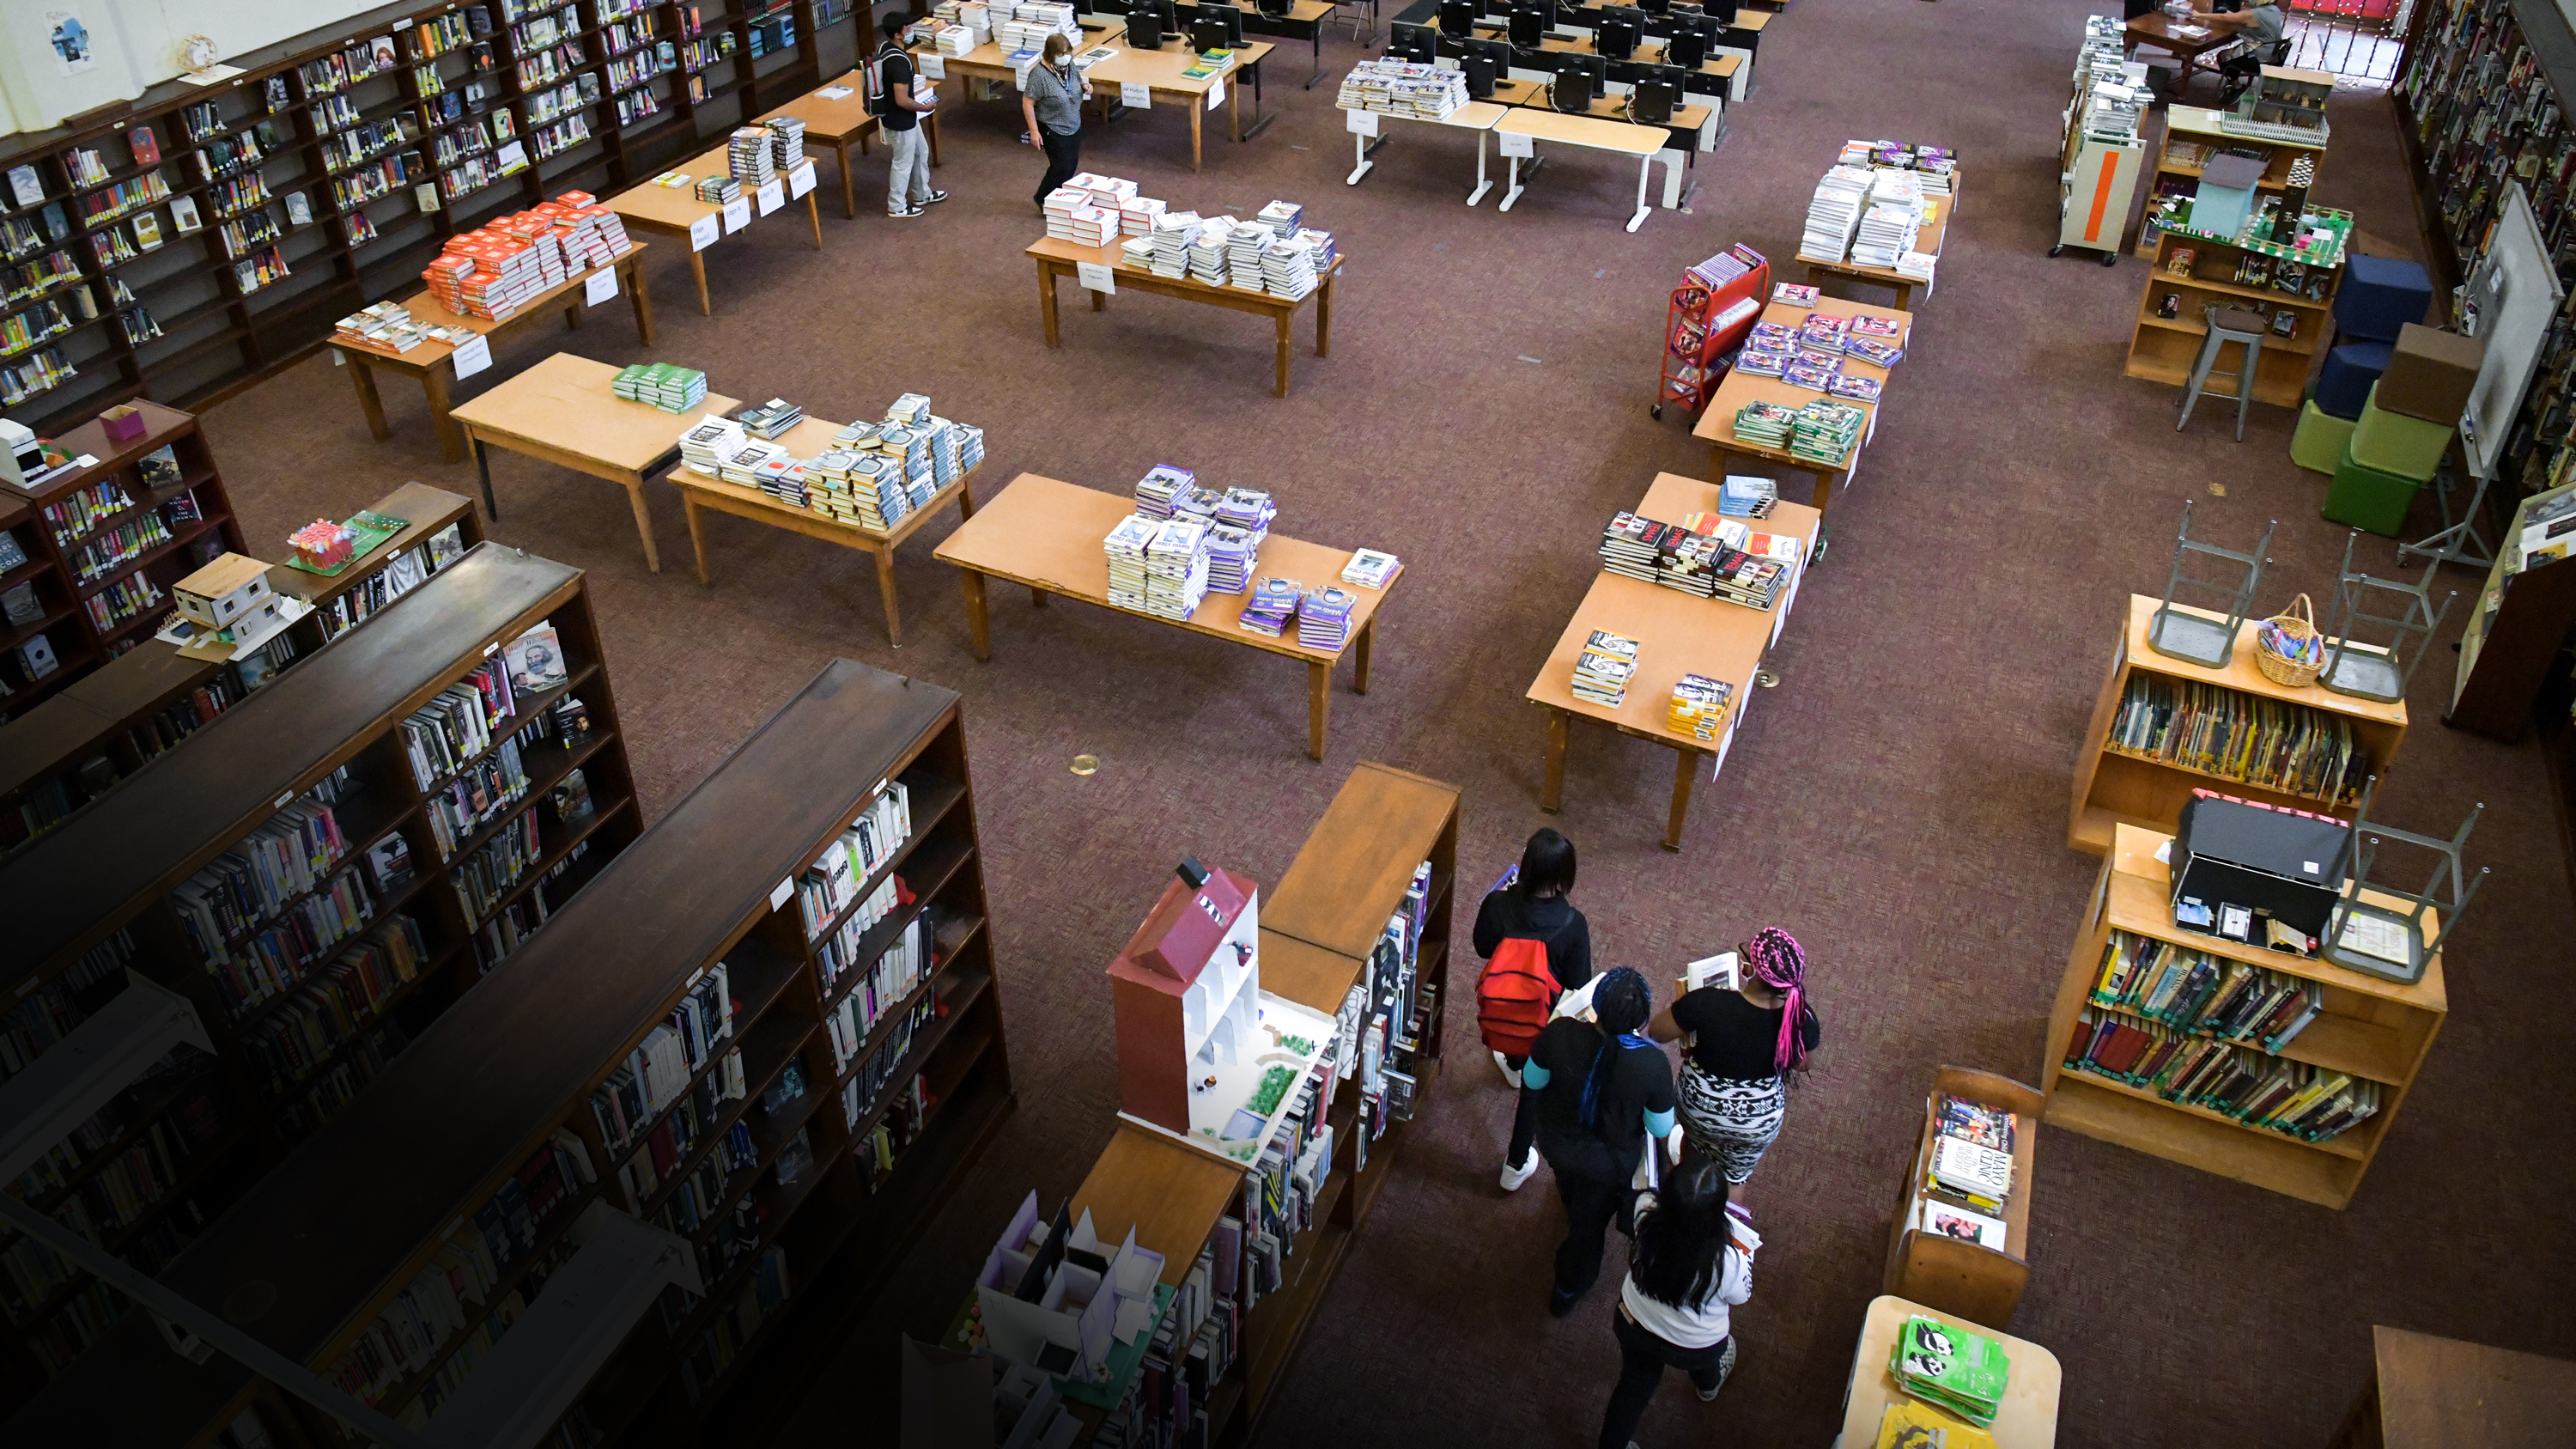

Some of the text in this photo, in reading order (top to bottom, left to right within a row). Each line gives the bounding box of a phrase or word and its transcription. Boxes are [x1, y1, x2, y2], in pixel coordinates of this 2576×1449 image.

[792, 174, 803, 184] Edge
[760, 191, 771, 200] Edge
[726, 208, 737, 218] Edge
[692, 226, 704, 235] Edge
[695, 233, 710, 246] (Basic)
[1641, 523, 1662, 543] TEMAS
[1666, 528, 1686, 548] TEMAS
[0, 554, 21, 569] COAT
[1723, 551, 1747, 572] TEMAS
[1954, 1146, 1964, 1174] WEIGHT
[1964, 1146, 1974, 1176] HEALTHY
[1978, 1150, 1993, 1184] CLINIC
[1990, 1153, 2008, 1186] MAYO
